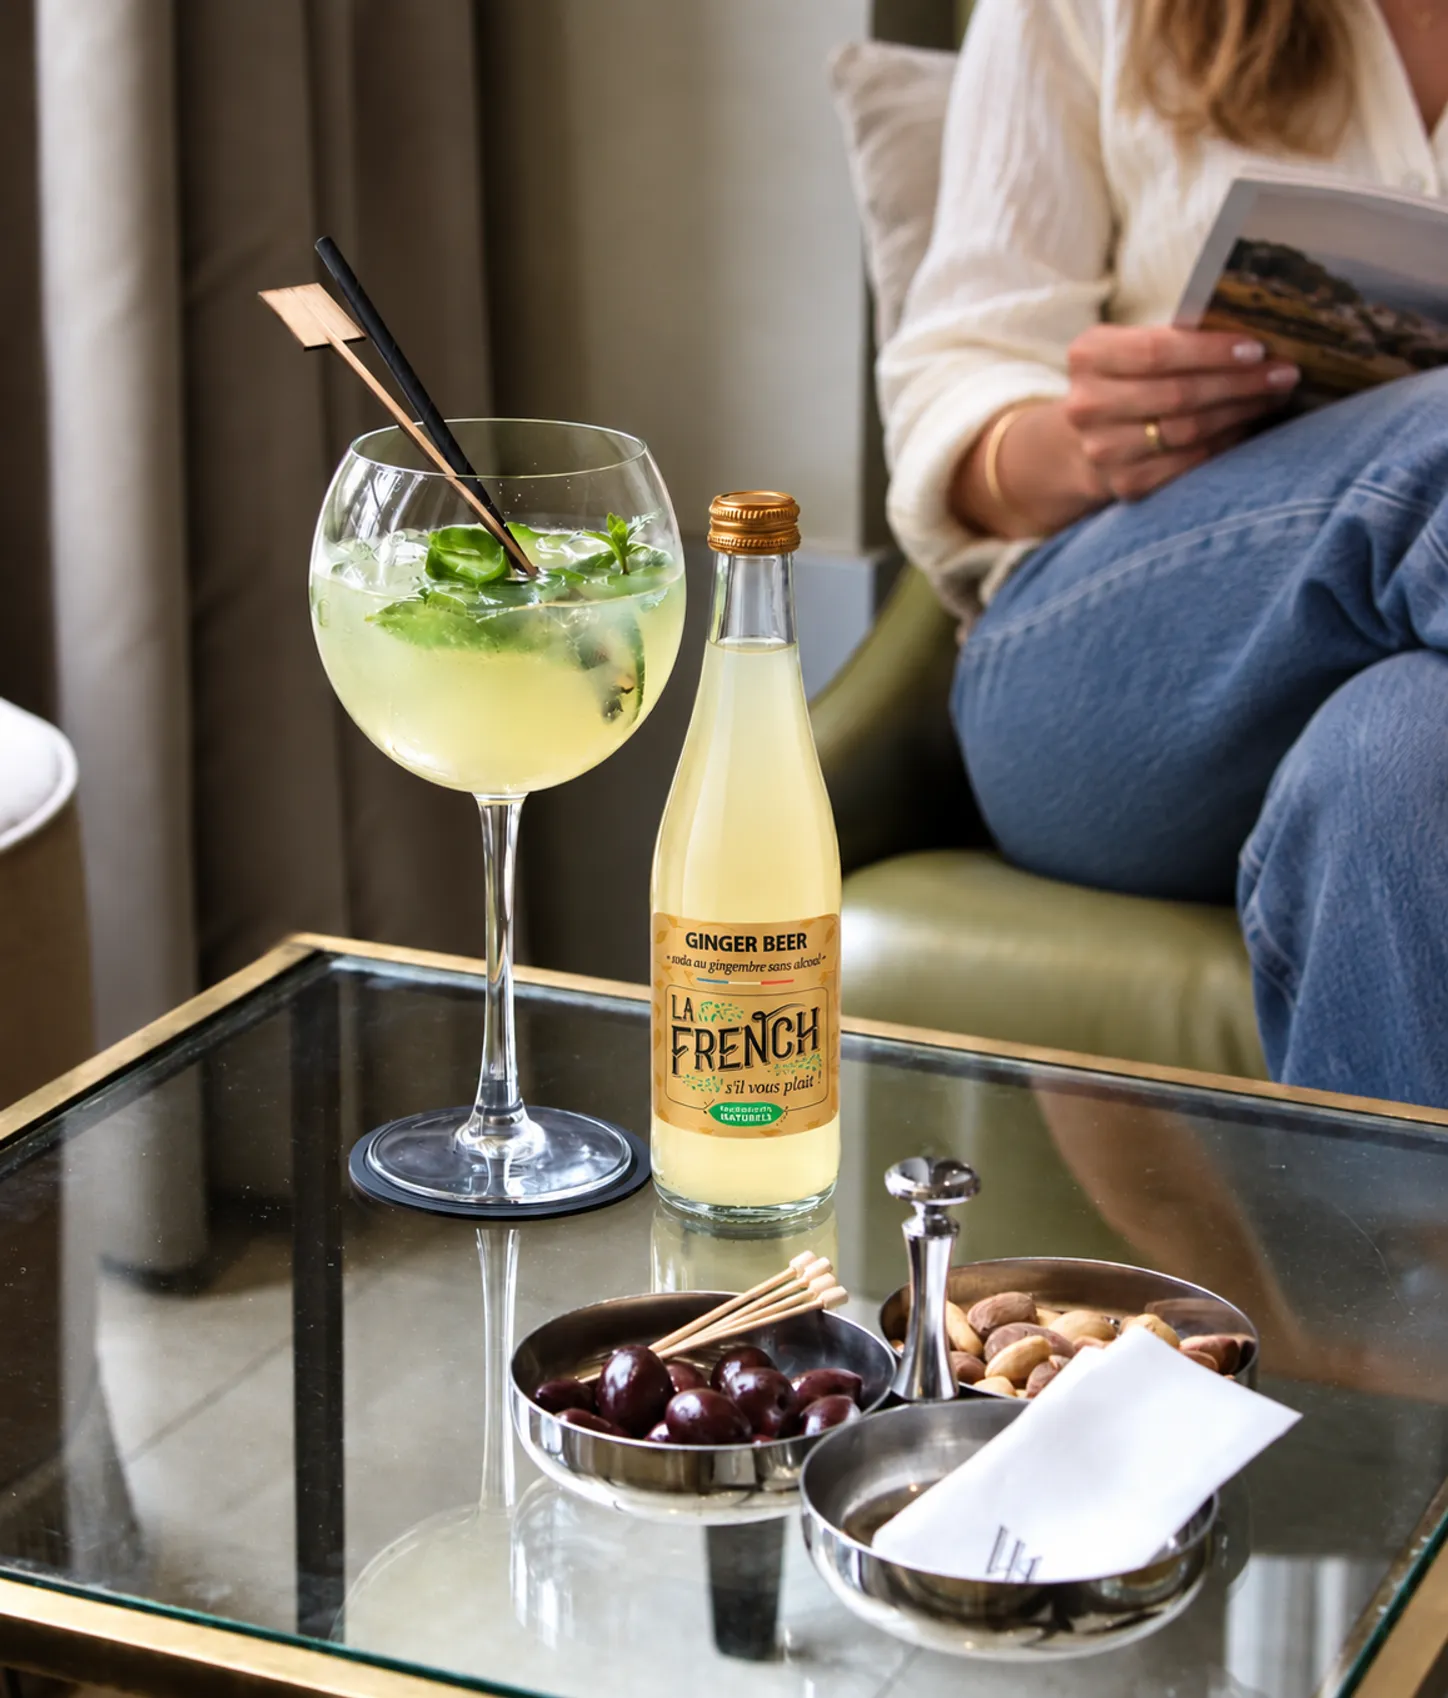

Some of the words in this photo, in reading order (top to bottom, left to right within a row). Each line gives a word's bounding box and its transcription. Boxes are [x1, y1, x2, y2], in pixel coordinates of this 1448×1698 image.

[685, 932, 758, 953] GINGER
[763, 932, 808, 953] BEER
[671, 954, 692, 967] soda
[693, 961, 707, 969] au
[708, 959, 766, 976] gingembre
[767, 961, 792, 973] sans
[793, 953, 822, 970] alcool
[671, 994, 694, 1022] LA
[671, 1003, 820, 1077] FRENCH
[725, 1080, 745, 1094] s'il
[748, 1082, 780, 1095] vous
